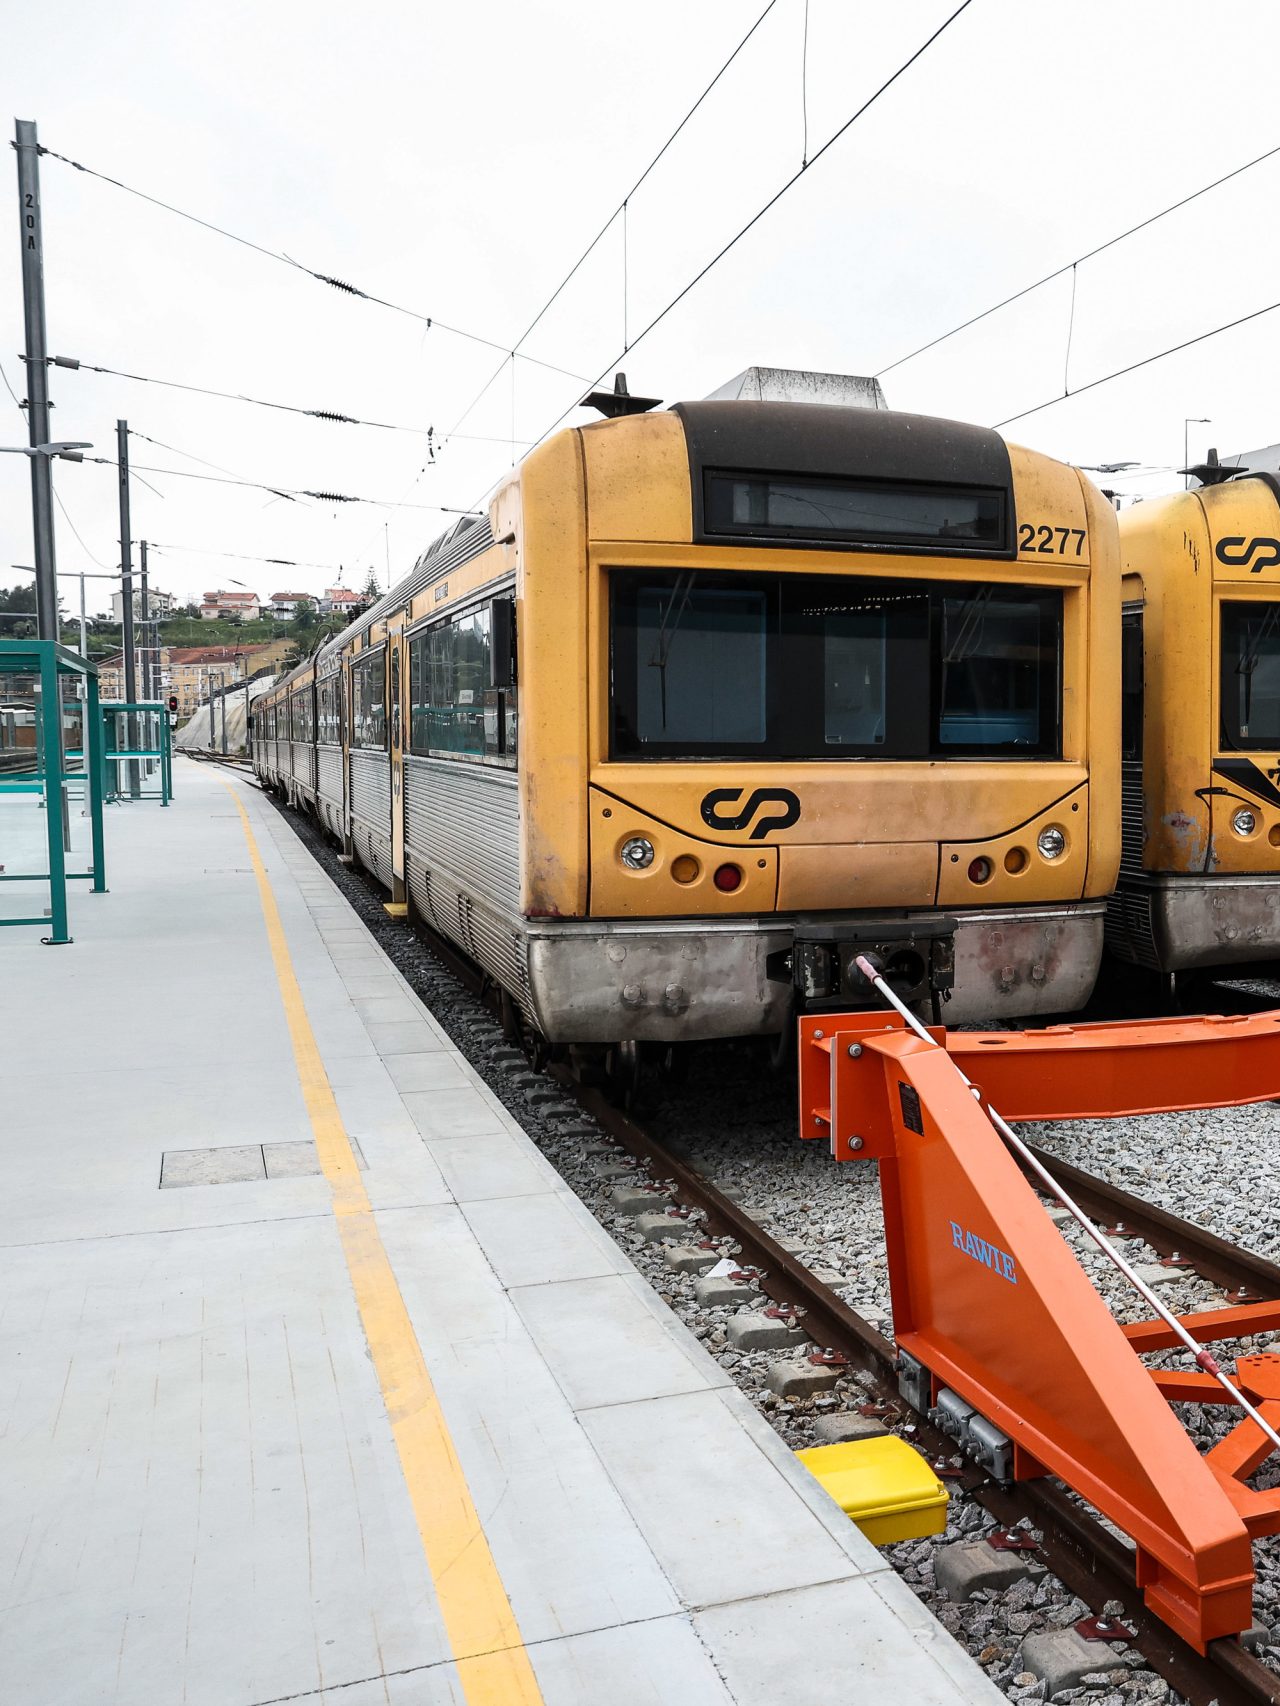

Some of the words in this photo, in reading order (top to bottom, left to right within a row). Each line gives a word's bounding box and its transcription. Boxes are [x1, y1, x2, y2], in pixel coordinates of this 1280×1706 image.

[25, 193, 36, 250] 20A
[1019, 524, 1086, 556] 2277
[701, 788, 801, 839] CP
[949, 1220, 1017, 1284] RAWIE
